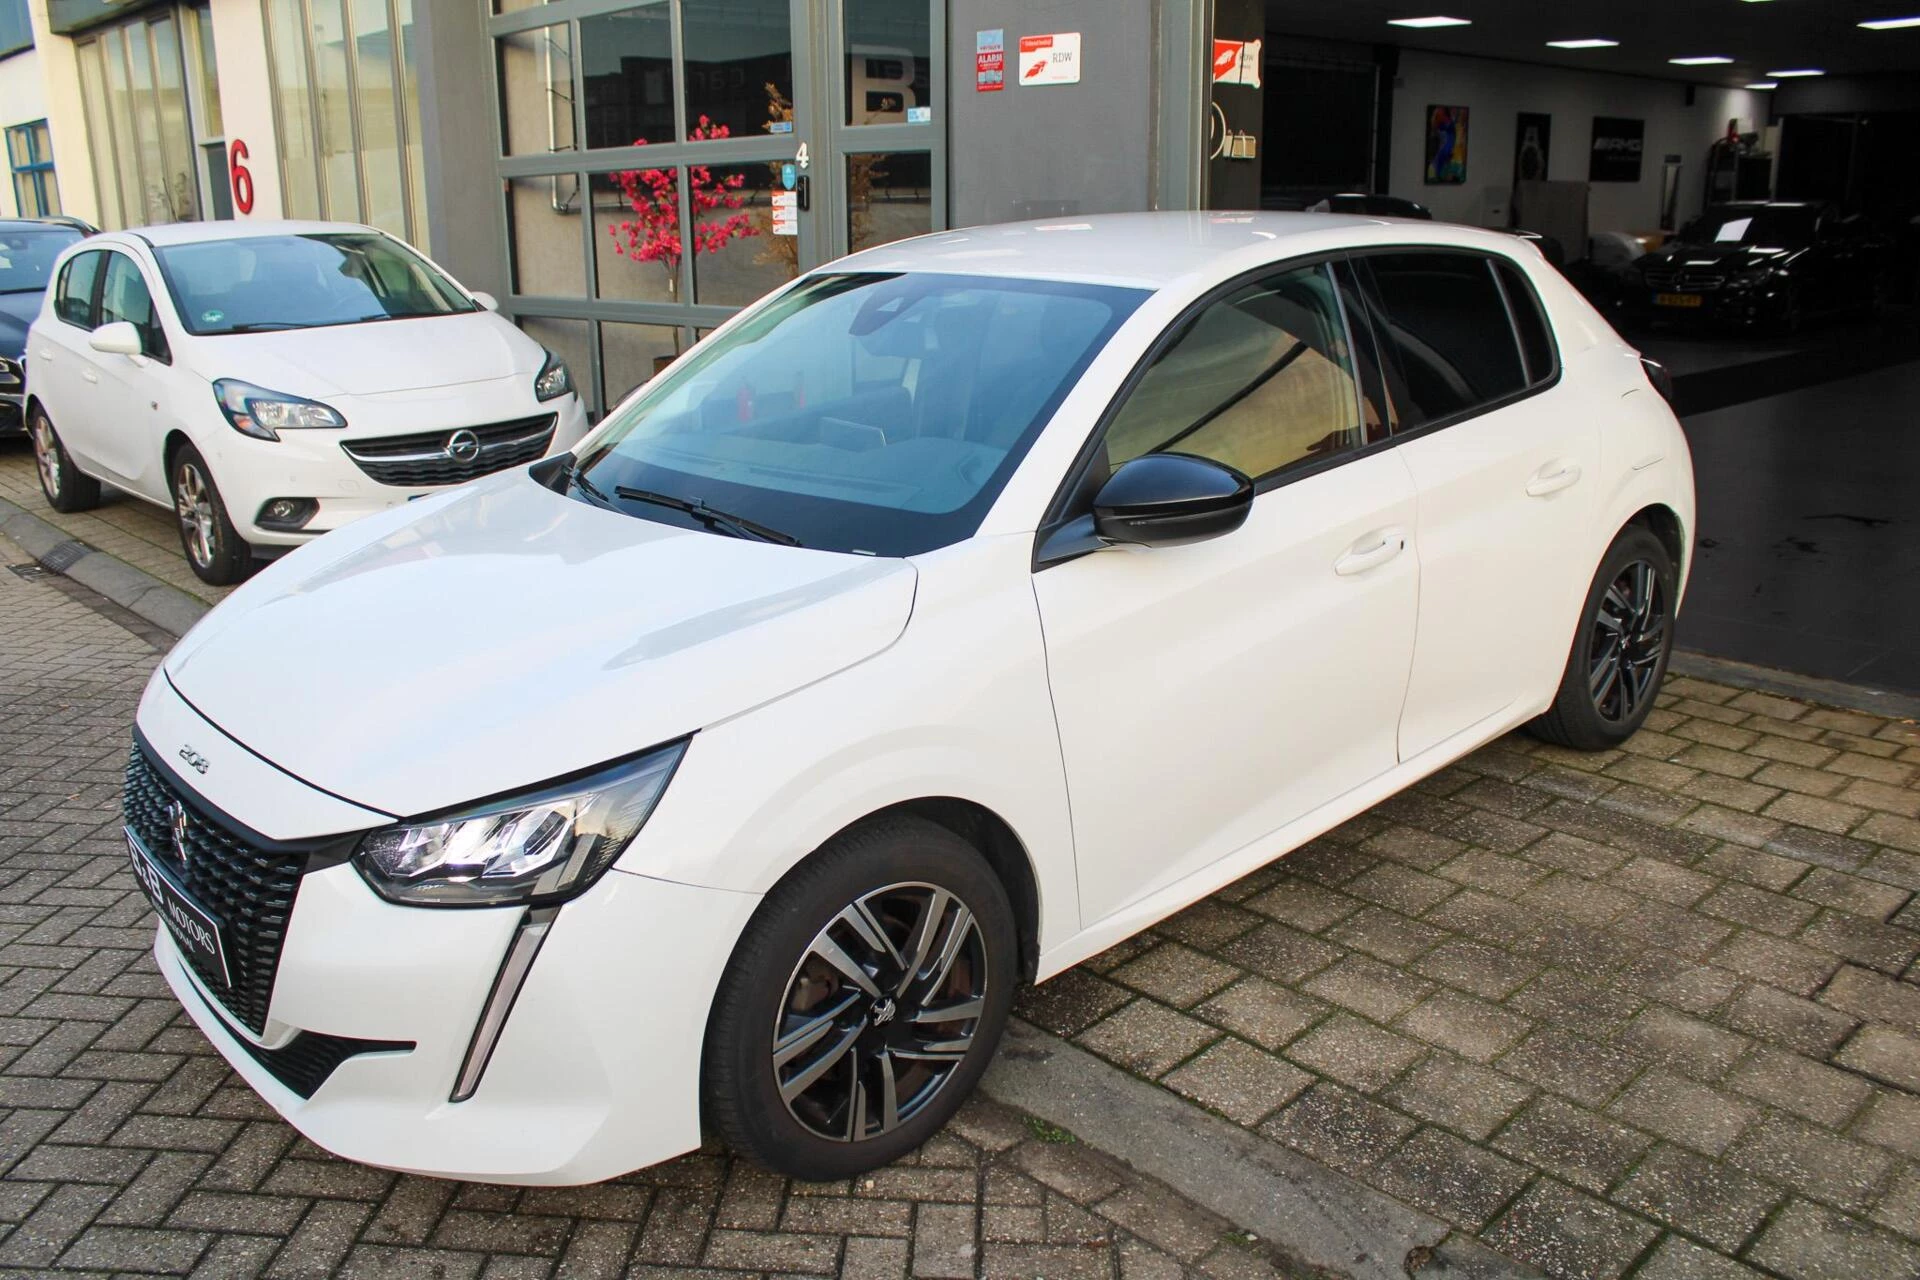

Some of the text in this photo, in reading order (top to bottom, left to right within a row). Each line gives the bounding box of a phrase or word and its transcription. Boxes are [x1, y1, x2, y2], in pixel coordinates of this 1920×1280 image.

[1052, 52, 1073, 64] RDW
[796, 142, 809, 169] 4
[230, 139, 254, 215] 6
[179, 744, 210, 775] 208
[167, 895, 215, 955] MOTORS
